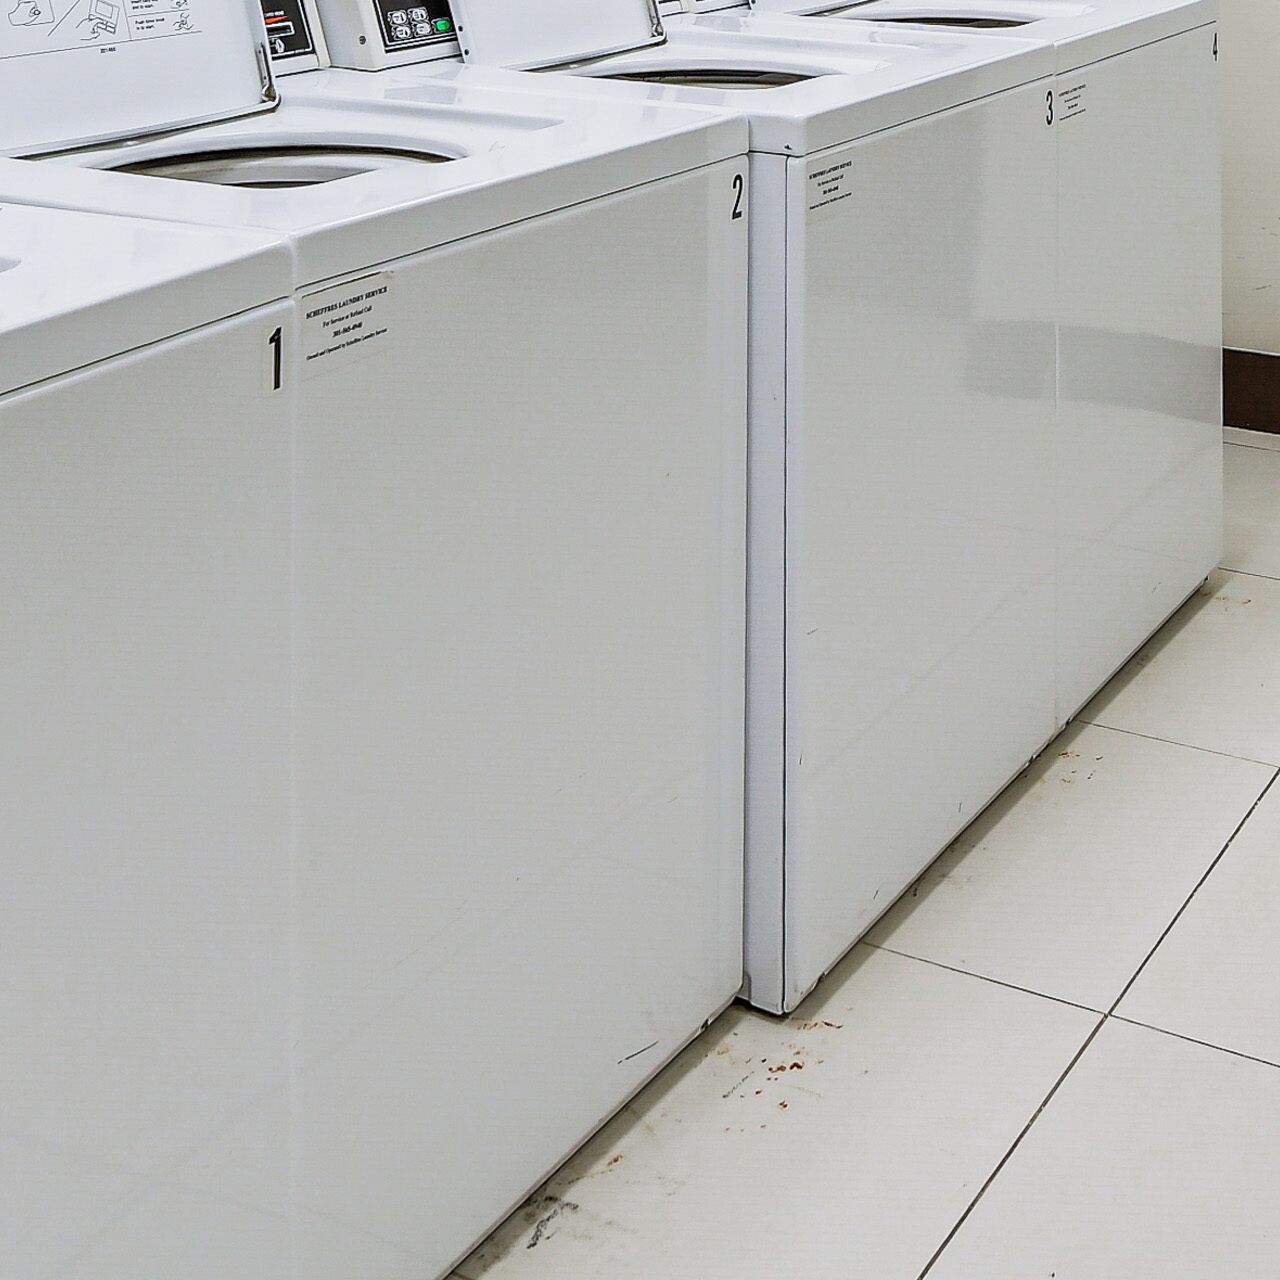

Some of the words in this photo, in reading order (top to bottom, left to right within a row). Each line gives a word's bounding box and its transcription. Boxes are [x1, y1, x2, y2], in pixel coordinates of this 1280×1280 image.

[1213, 32, 1218, 61] 4
[1046, 90, 1053, 125] 3
[732, 174, 743, 220] 2
[268, 327, 282, 390] 1
